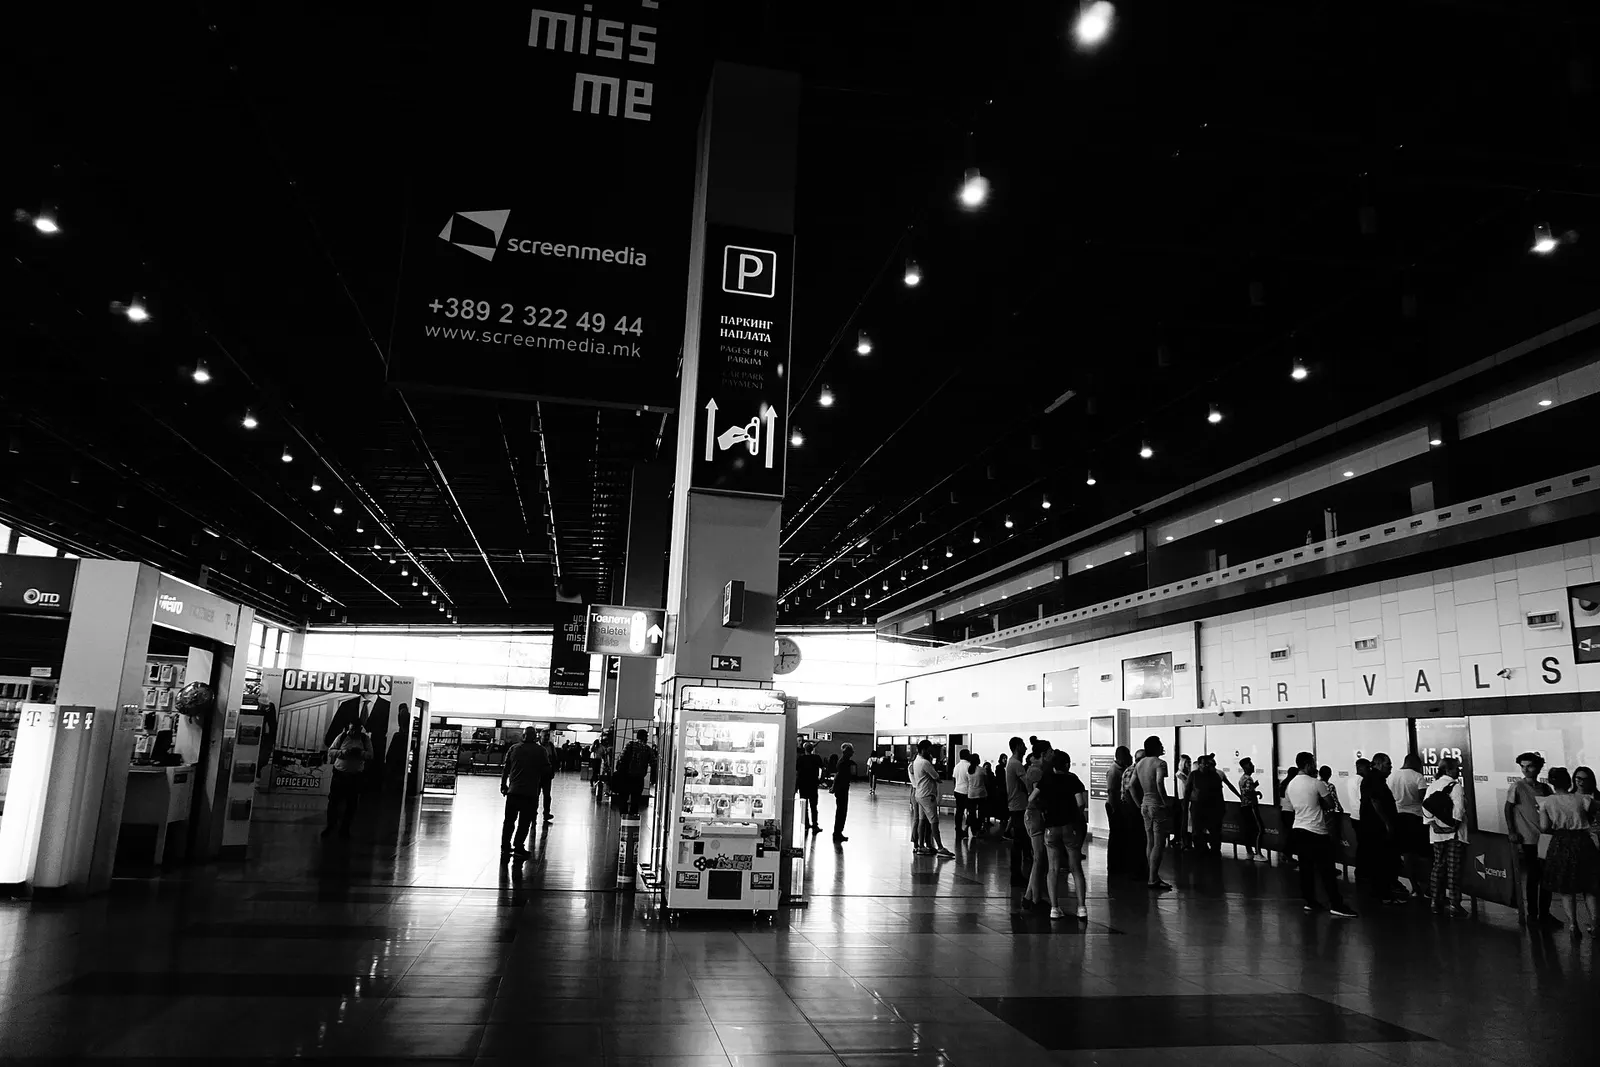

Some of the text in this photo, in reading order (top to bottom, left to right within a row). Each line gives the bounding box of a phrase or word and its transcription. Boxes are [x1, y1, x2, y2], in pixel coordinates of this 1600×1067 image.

[527, 4, 658, 66] miss
[572, 72, 654, 122] me
[507, 236, 648, 267] screenmedia
[737, 253, 764, 291] P
[428, 297, 643, 337] +389 2 322 49 44
[720, 315, 774, 330] ПАРКИНГ
[425, 324, 642, 359] www.screenmedia.mk
[720, 328, 772, 343] НАПЛАТА
[727, 355, 762, 366] PARKIM
[572, 614, 587, 624] you
[591, 613, 630, 625] Тоалети
[566, 632, 587, 642] miss
[284, 669, 391, 694] OFFICE PLUS
[1208, 656, 1562, 707] ARRIVALS
[63, 712, 80, 729] T
[1422, 747, 1438, 764] 15
[276, 776, 320, 788] OFFICE PLUS
